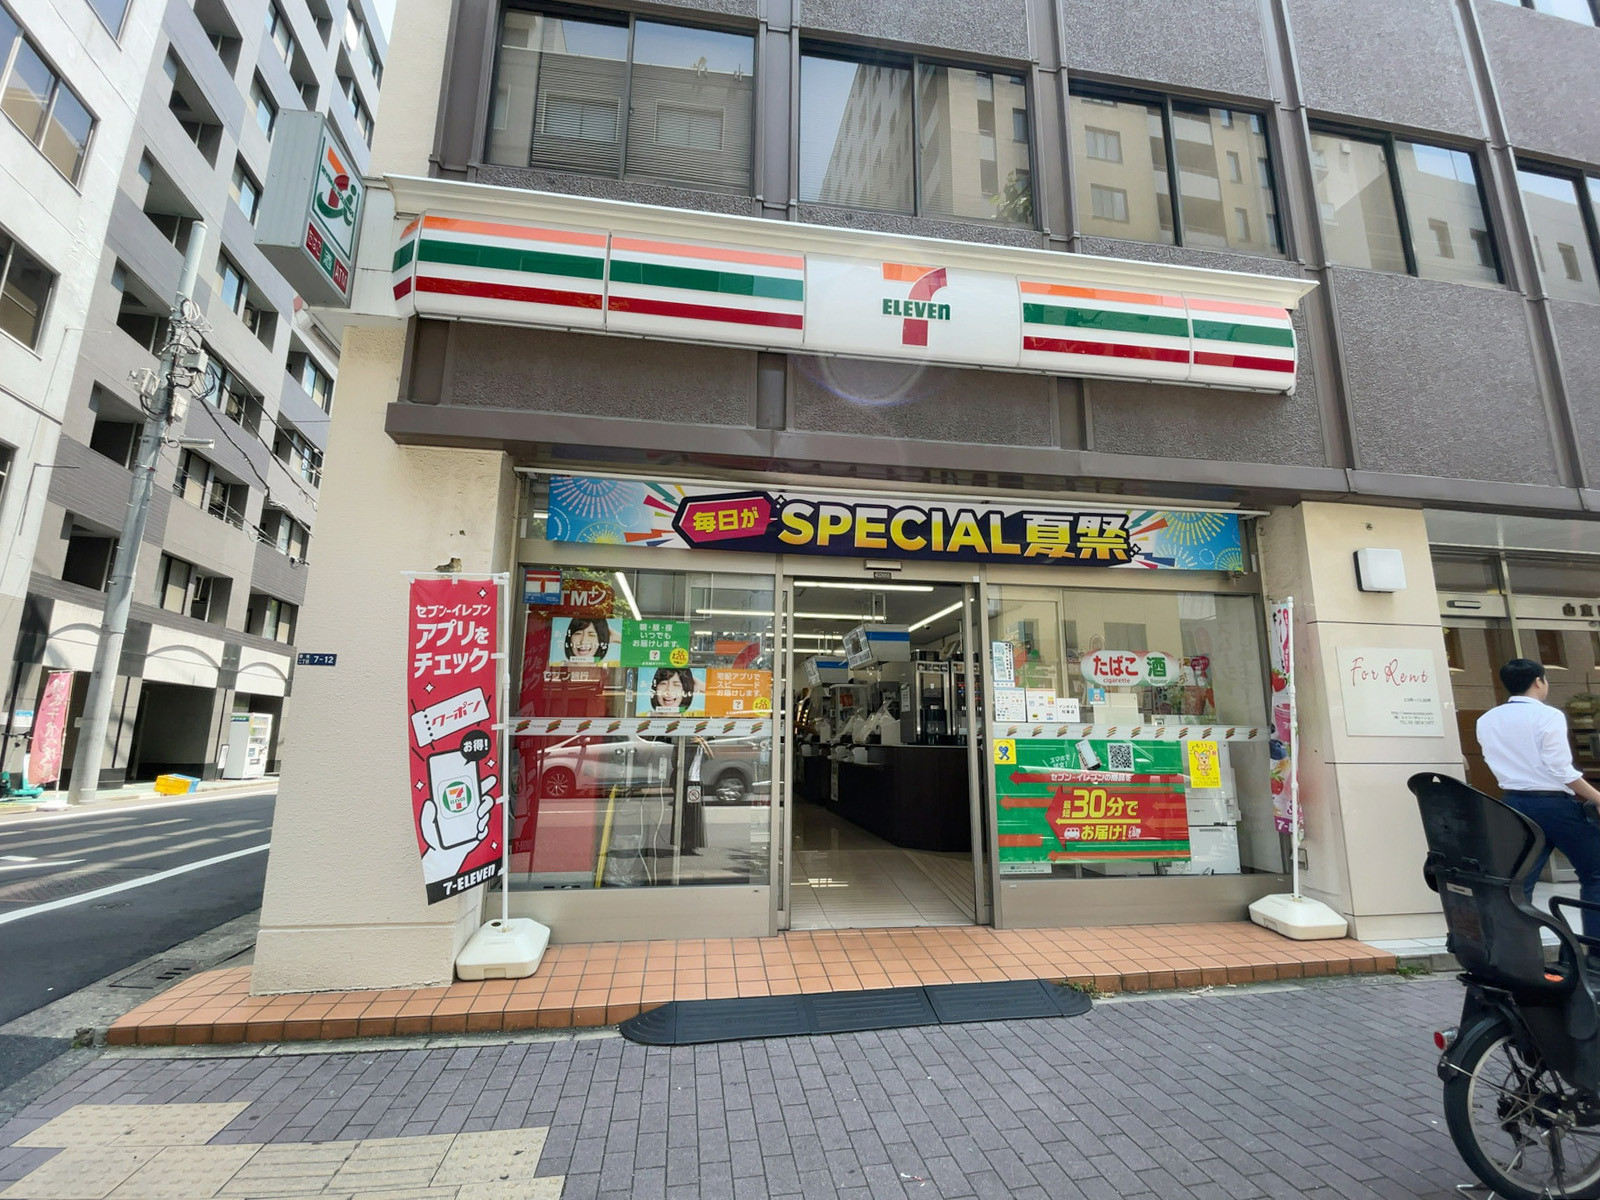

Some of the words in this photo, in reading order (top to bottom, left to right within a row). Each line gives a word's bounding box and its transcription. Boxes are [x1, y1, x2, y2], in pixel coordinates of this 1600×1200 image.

[334, 264, 347, 289] ATM
[692, 506, 759, 533] 毎日が
[415, 619, 490, 650] アプリを
[640, 632, 671, 640] いつでも
[313, 655, 334, 664] 7-12
[414, 647, 489, 679] チェック
[1093, 655, 1139, 677] たばこ
[1147, 656, 1167, 677] 酒
[1350, 656, 1379, 687] For
[1384, 658, 1428, 687] Rent
[432, 700, 482, 727] クーポン
[1071, 789, 1139, 818] 30分で
[1081, 824, 1127, 840] お届け!
